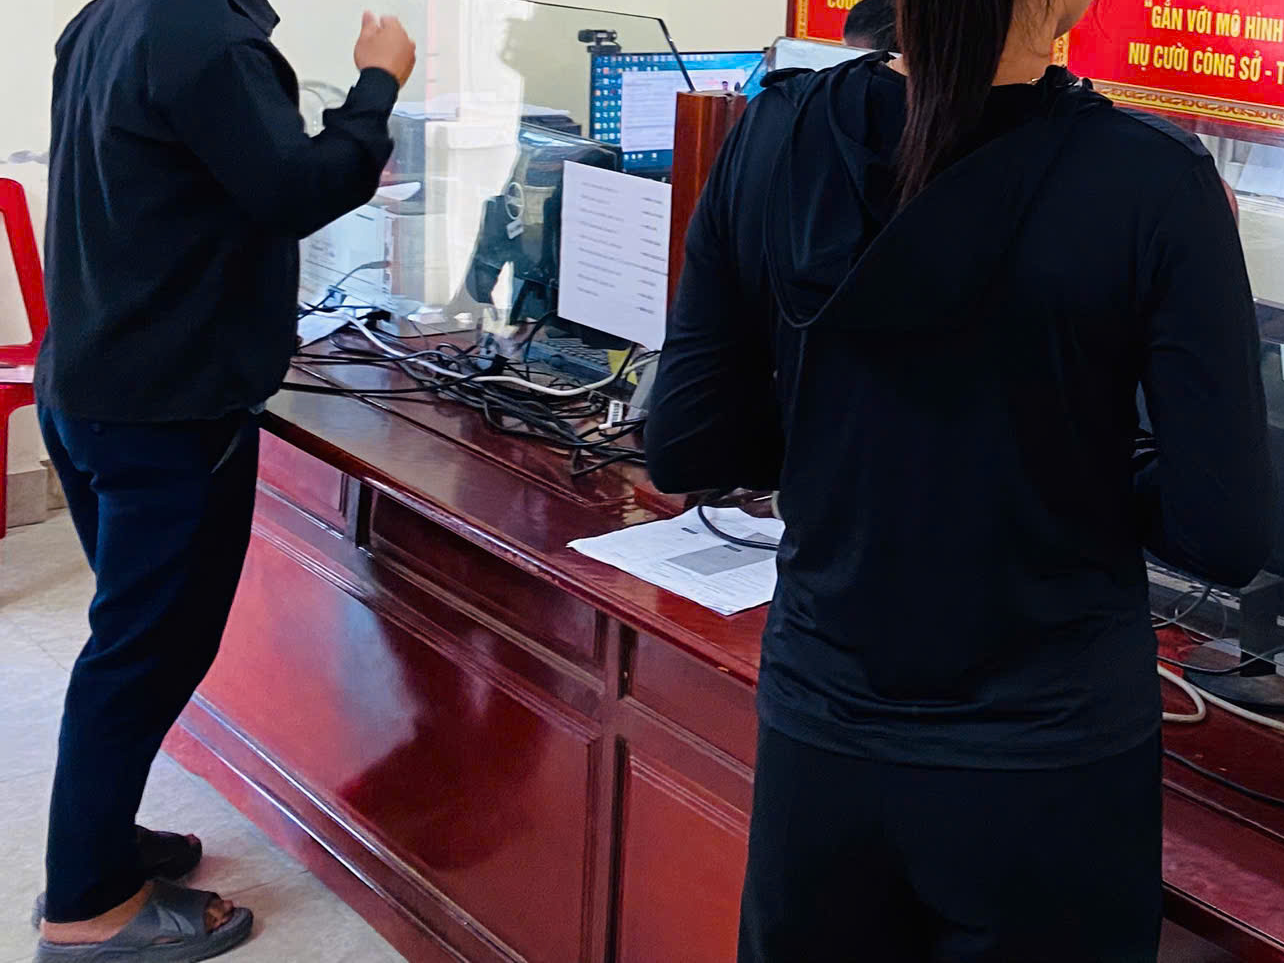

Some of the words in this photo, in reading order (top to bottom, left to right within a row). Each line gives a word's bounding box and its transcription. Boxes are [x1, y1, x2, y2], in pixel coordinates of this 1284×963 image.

[1186, 5, 1213, 34] VỚI
[1214, 13, 1242, 37] MÔ
[1244, 14, 1284, 42] HÌNH
[1127, 42, 1151, 69] NỤ
[1152, 46, 1190, 70] CƯỜI
[1192, 46, 1236, 77] CÔNG
[1239, 50, 1263, 85] SỞ
